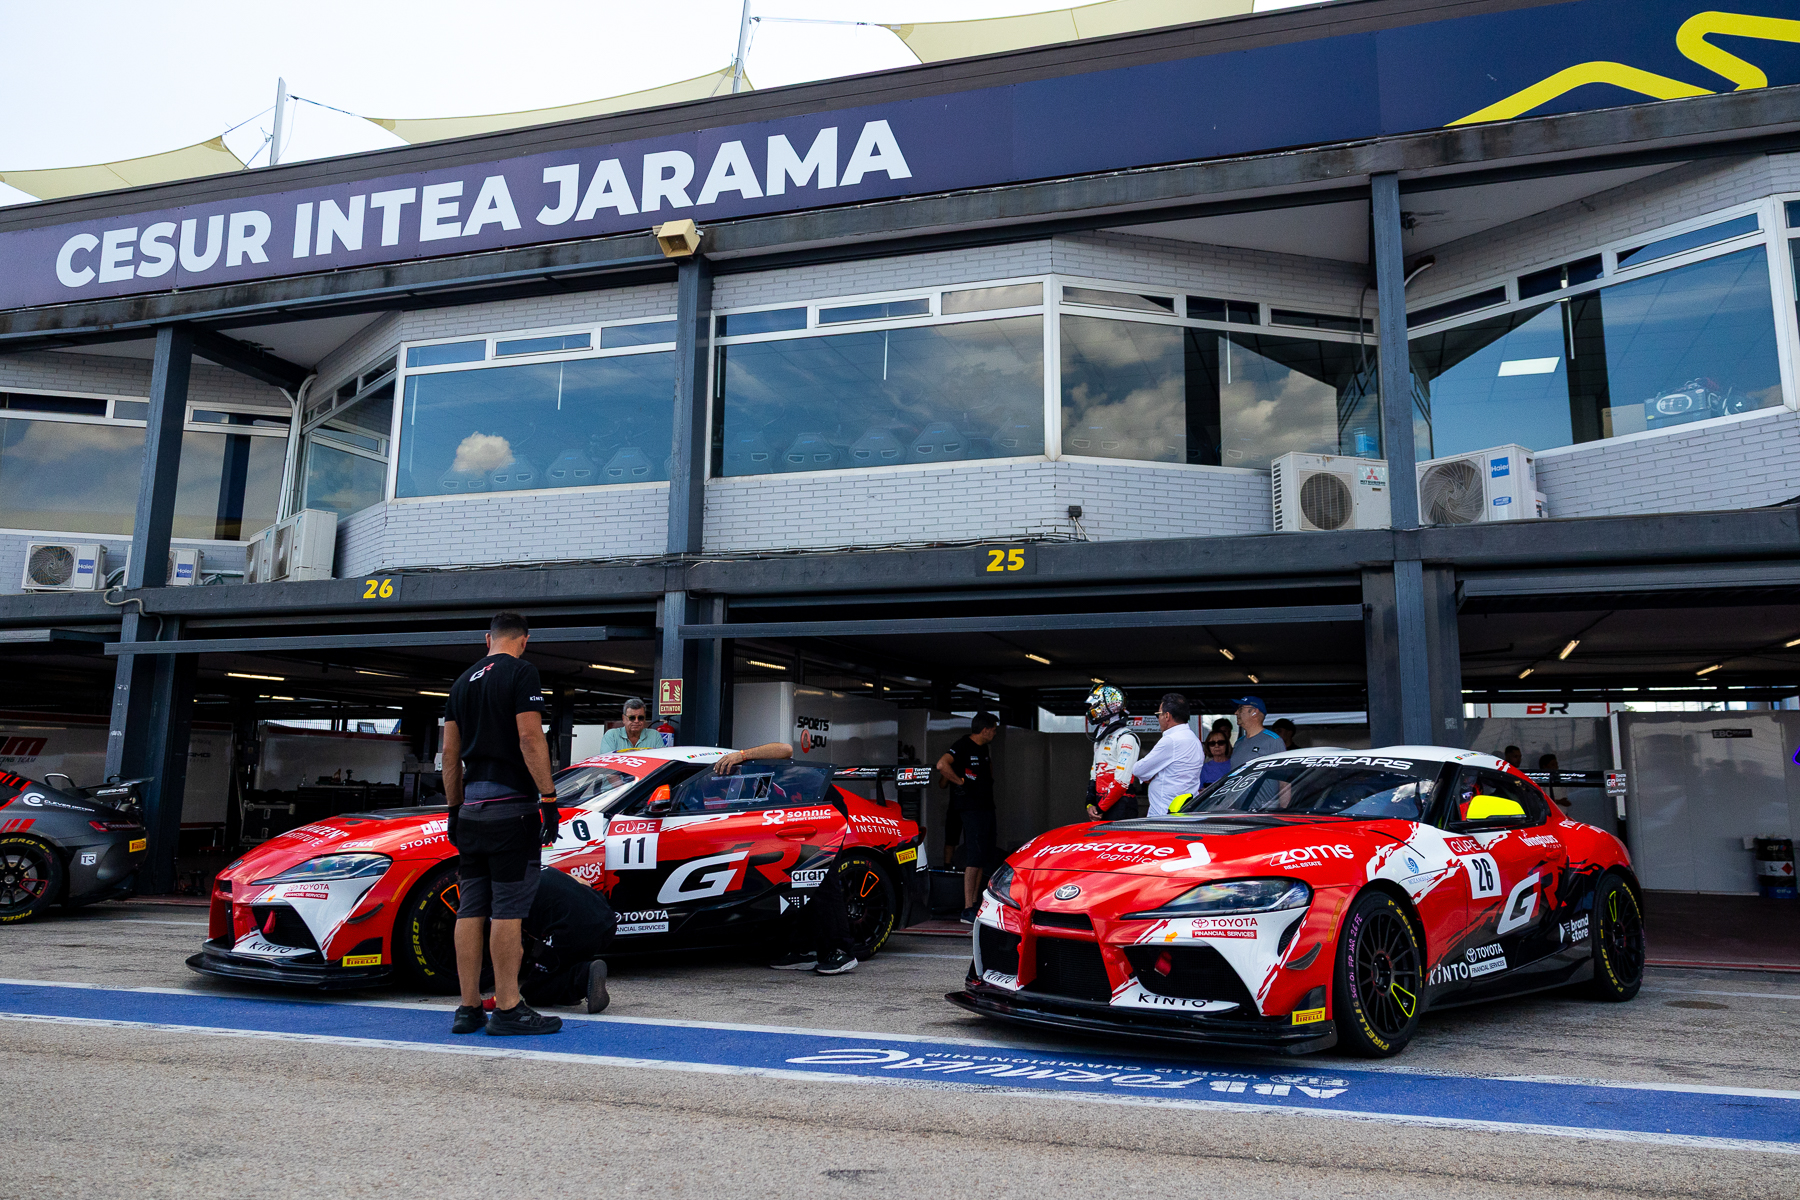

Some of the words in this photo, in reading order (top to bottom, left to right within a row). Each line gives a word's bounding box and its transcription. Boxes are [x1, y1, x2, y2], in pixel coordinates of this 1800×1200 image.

[56, 210, 272, 288] CESUR
[293, 175, 519, 258] INTEA
[536, 120, 912, 226] JARAMA
[987, 548, 1025, 572] 25
[363, 578, 394, 599] 26
[797, 716, 830, 731] SPORTS
[1713, 730, 1733, 738] EBC
[1253, 756, 1414, 772] SUPERCARS
[897, 772, 913, 780] GR
[856, 825, 902, 837] INSTITUTE
[400, 834, 449, 850] STORYT
[1033, 841, 1175, 858] transcrane
[622, 837, 646, 864] 11
[1096, 852, 1160, 866] logistics
[1300, 860, 1322, 868] ESTATE
[657, 843, 802, 904] GR
[1471, 858, 1494, 892] 26
[299, 883, 330, 891] TOYOTA
[1497, 863, 1559, 935] GR
[623, 909, 669, 921] TOYOTA
[1211, 918, 1258, 928] TOYOTA
[1571, 913, 1589, 931] brand
[1571, 927, 1589, 943] store
[1476, 942, 1504, 960] TOYOTA
[346, 956, 379, 966] PIRELLI
[1295, 1010, 1323, 1024] PIRELLI
[925, 1052, 1142, 1072] CHAMPIONSHIP
[1155, 1067, 1260, 1080] WORLD
